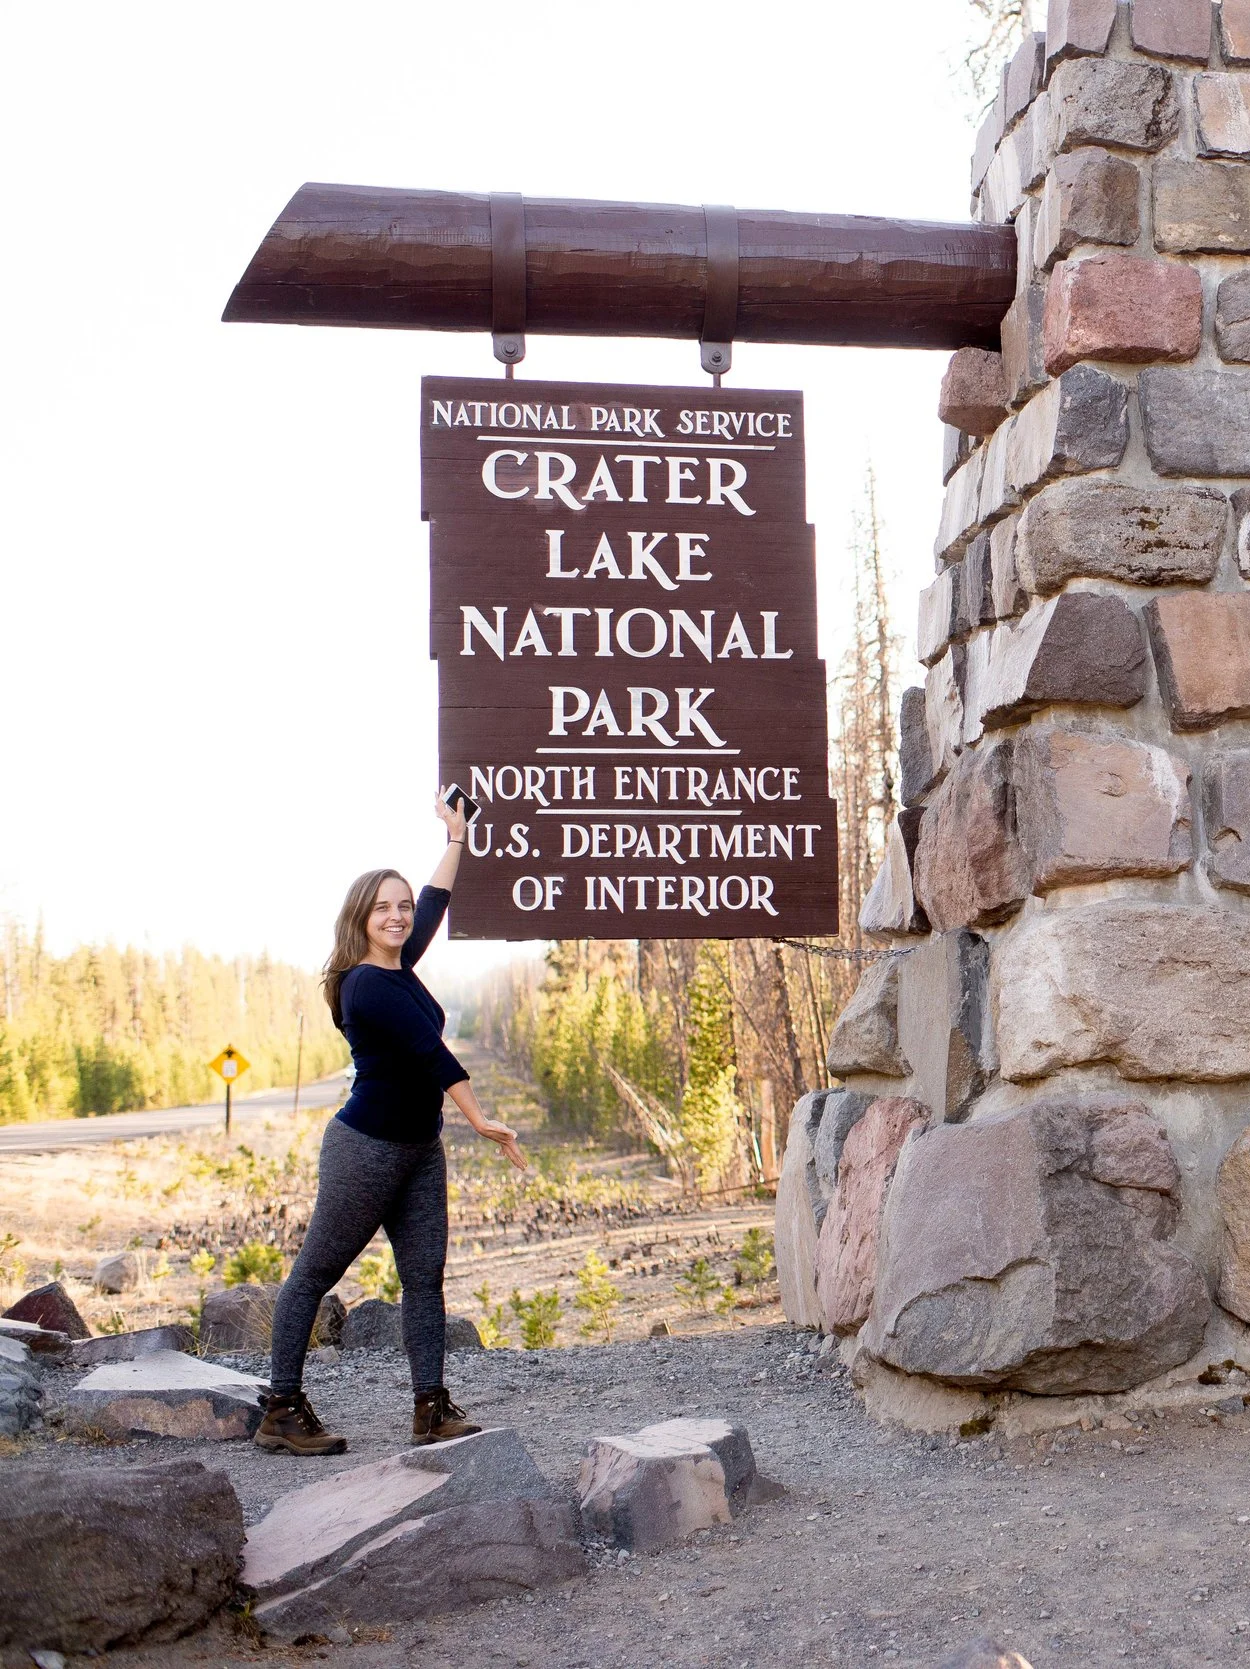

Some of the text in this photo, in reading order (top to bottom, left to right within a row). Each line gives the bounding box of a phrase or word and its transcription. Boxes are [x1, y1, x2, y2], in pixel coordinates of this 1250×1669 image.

[432, 400, 793, 440] NATIONAL PARK SERVICE
[481, 449, 757, 516] CRATER
[545, 529, 713, 591] LAKE
[459, 606, 794, 664] NATIONAL
[548, 686, 728, 748] PARK
[469, 766, 802, 807] NORTH ENTRANCE
[467, 823, 822, 865] U.S. DEPARTMENT
[512, 875, 780, 917] OF INTERIOR
